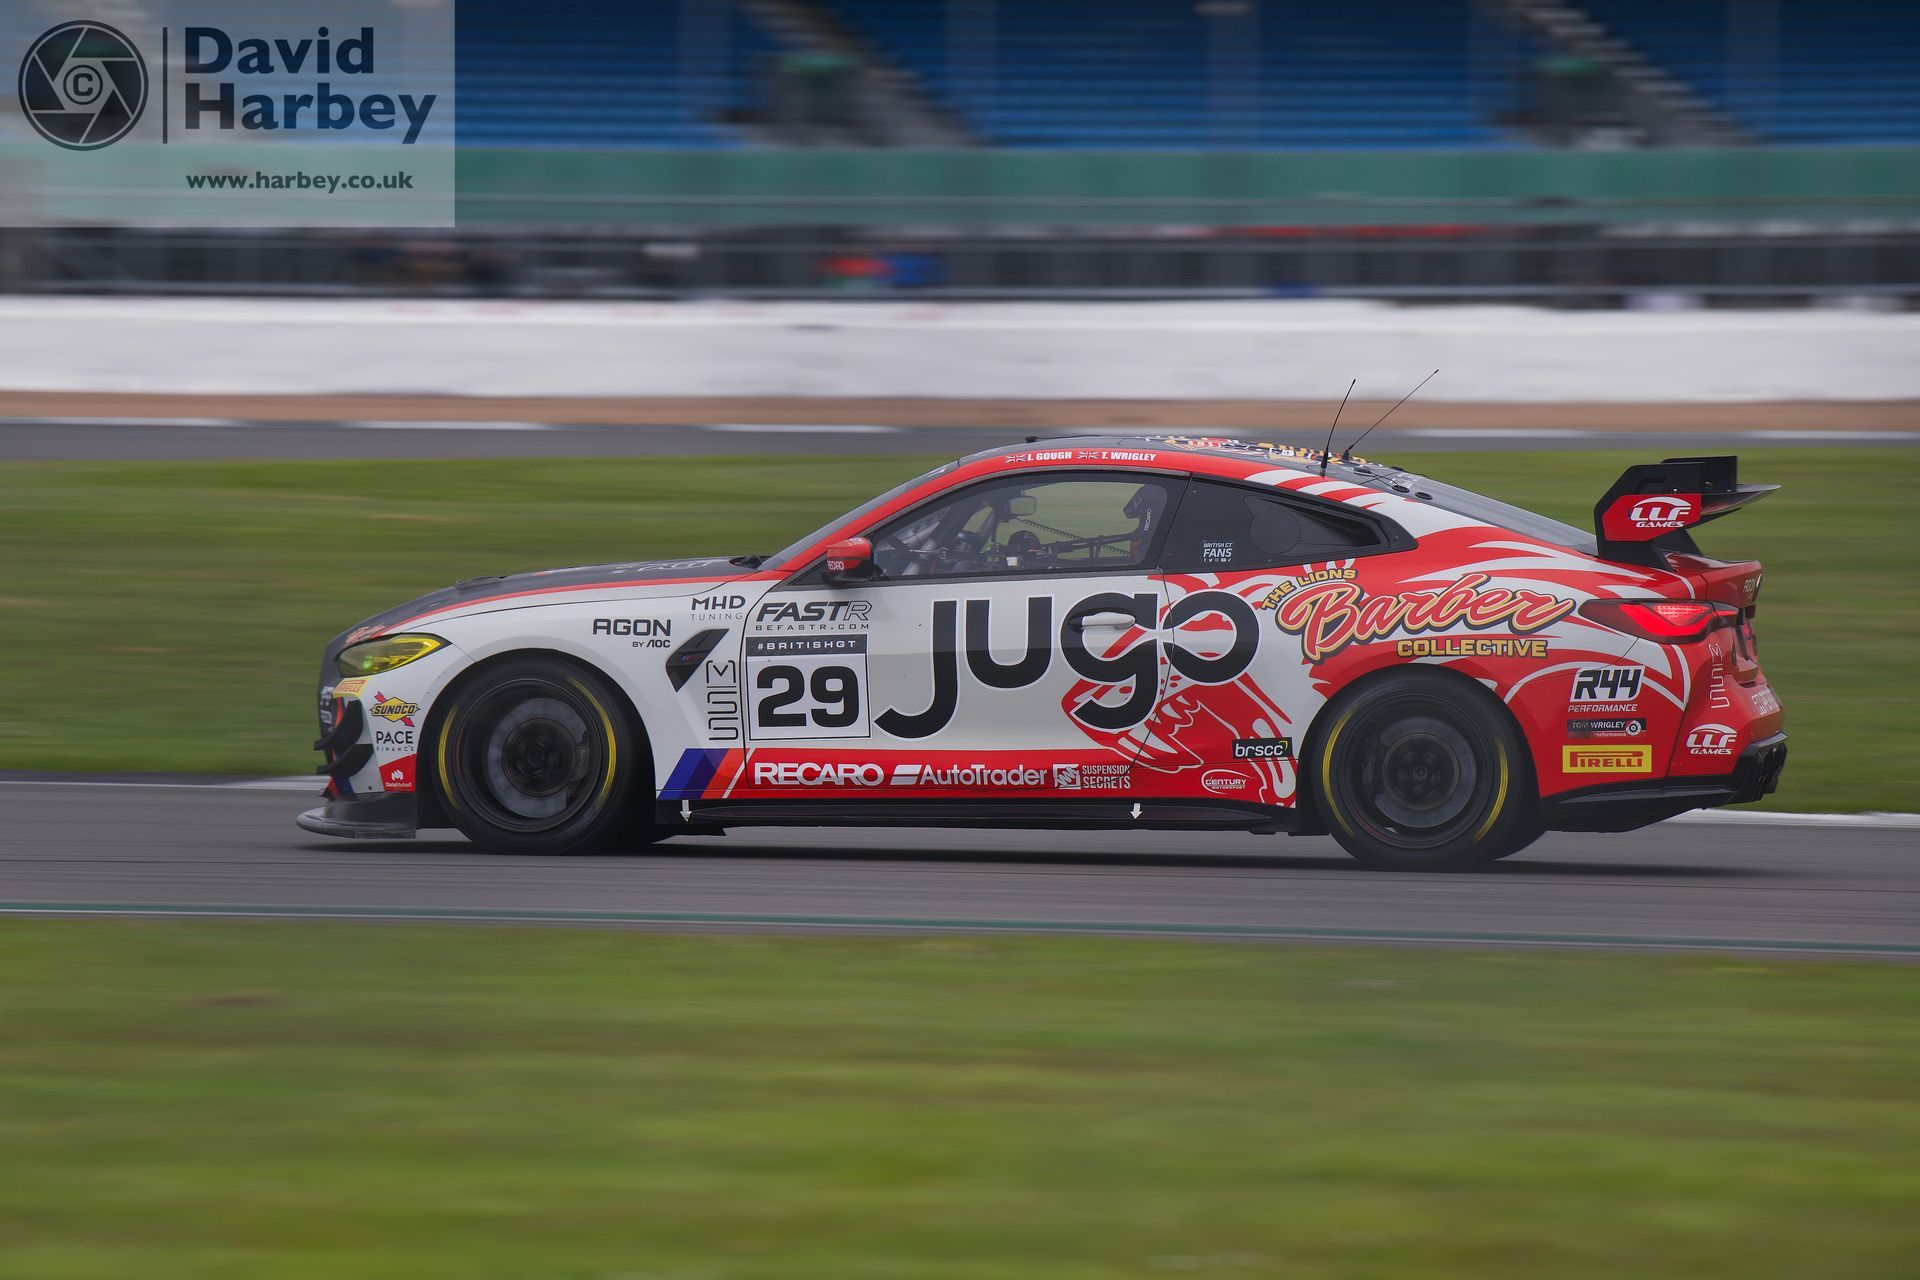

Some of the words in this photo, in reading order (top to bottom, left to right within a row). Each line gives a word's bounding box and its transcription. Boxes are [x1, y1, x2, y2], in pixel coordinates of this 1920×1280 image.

[1036, 452, 1072, 461] GOUGH
[1101, 451, 1108, 459] T.
[1111, 452, 1156, 461] WRIGLEY
[1203, 548, 1233, 558] FANS
[1260, 580, 1297, 611] THE
[1297, 567, 1357, 586] LIONS
[691, 595, 746, 611] MHD
[691, 612, 744, 622] TUNING
[756, 600, 873, 622] FASTR
[1276, 573, 1577, 665] Barber
[593, 618, 671, 637] AGON
[756, 623, 870, 631] BEFASTR.COM
[757, 640, 856, 651] #BRITISHGT
[1396, 638, 1548, 658] COLLECTIVE
[1574, 667, 1643, 700] R44
[757, 665, 859, 727] 29
[374, 705, 415, 715] SUNOCO
[1568, 703, 1638, 713] PERFORMANCE
[1590, 721, 1626, 729] WRIGLEY
[376, 731, 414, 744] PACE
[1235, 743, 1284, 757] brscc
[1570, 751, 1643, 768] PIRELLI
[754, 762, 884, 786] RECARO
[919, 764, 1047, 786] AutoTrader
[1082, 764, 1131, 776] SUSPENSION
[1082, 775, 1131, 789] SECRETS
[1205, 777, 1247, 785] CENTURY
